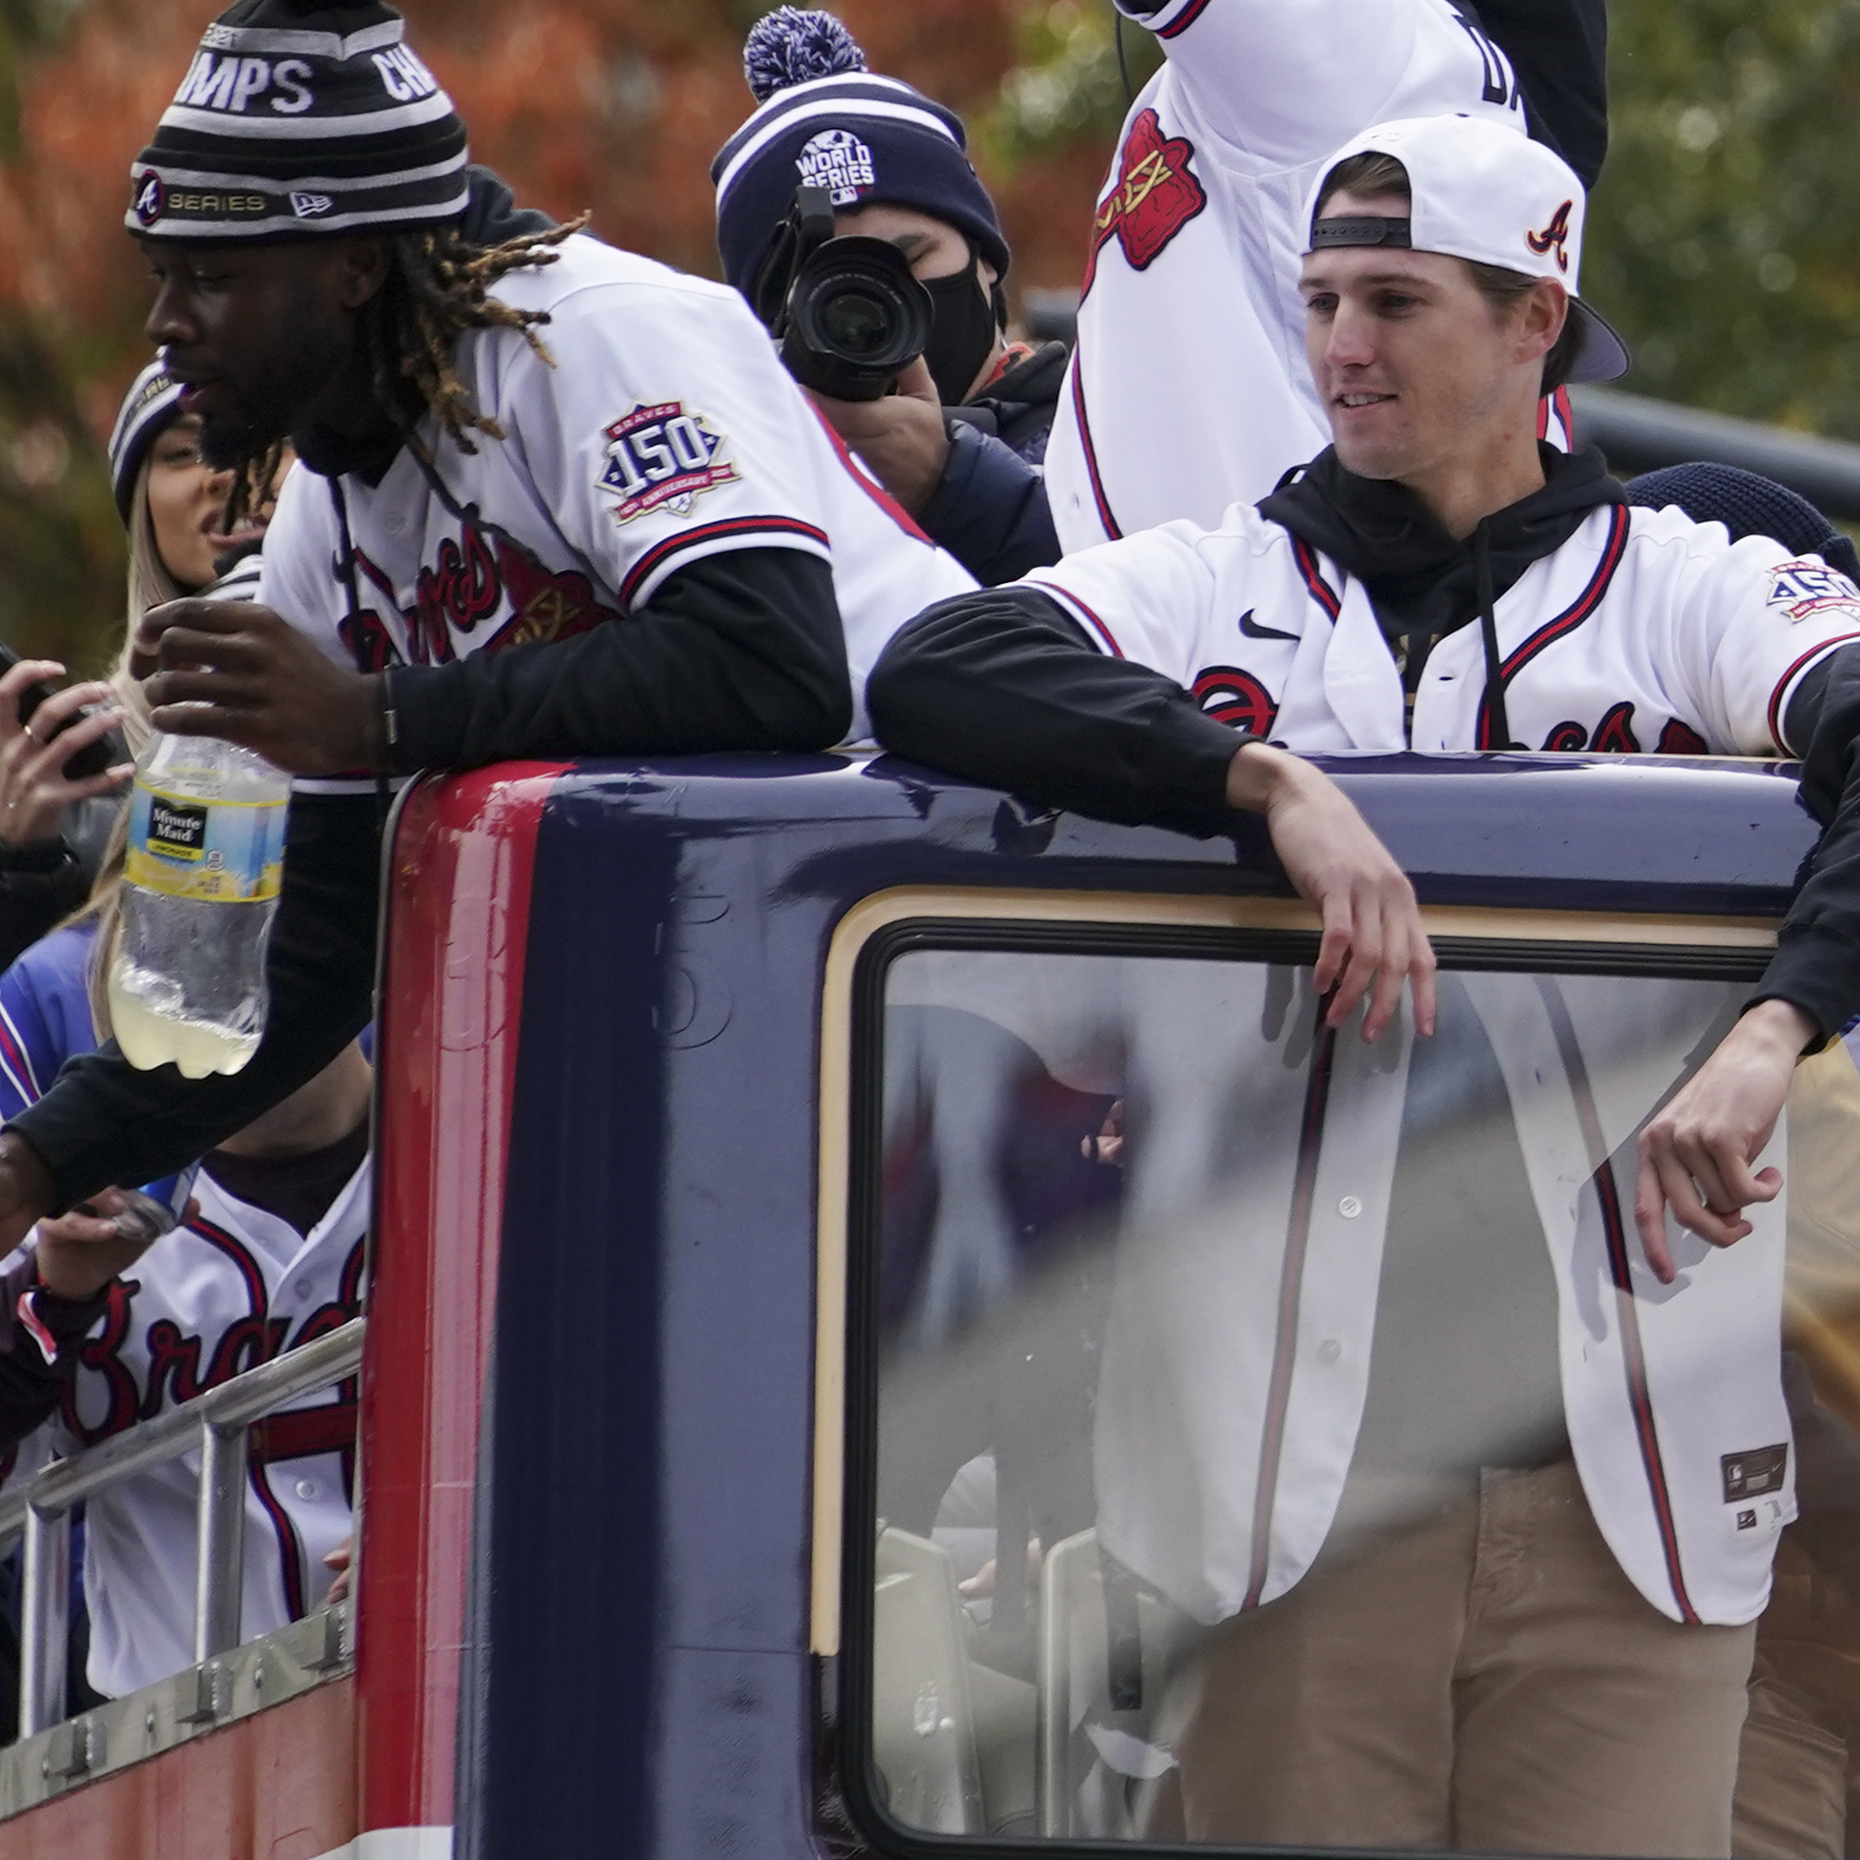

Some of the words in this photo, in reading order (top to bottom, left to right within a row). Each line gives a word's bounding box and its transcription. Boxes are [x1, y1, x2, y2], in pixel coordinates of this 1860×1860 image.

[795, 145, 871, 177] WORLD
[168, 193, 266, 212] SERIES
[606, 415, 711, 499] 150
[153, 807, 201, 831] Minute
[156, 822, 194, 843] Maid
